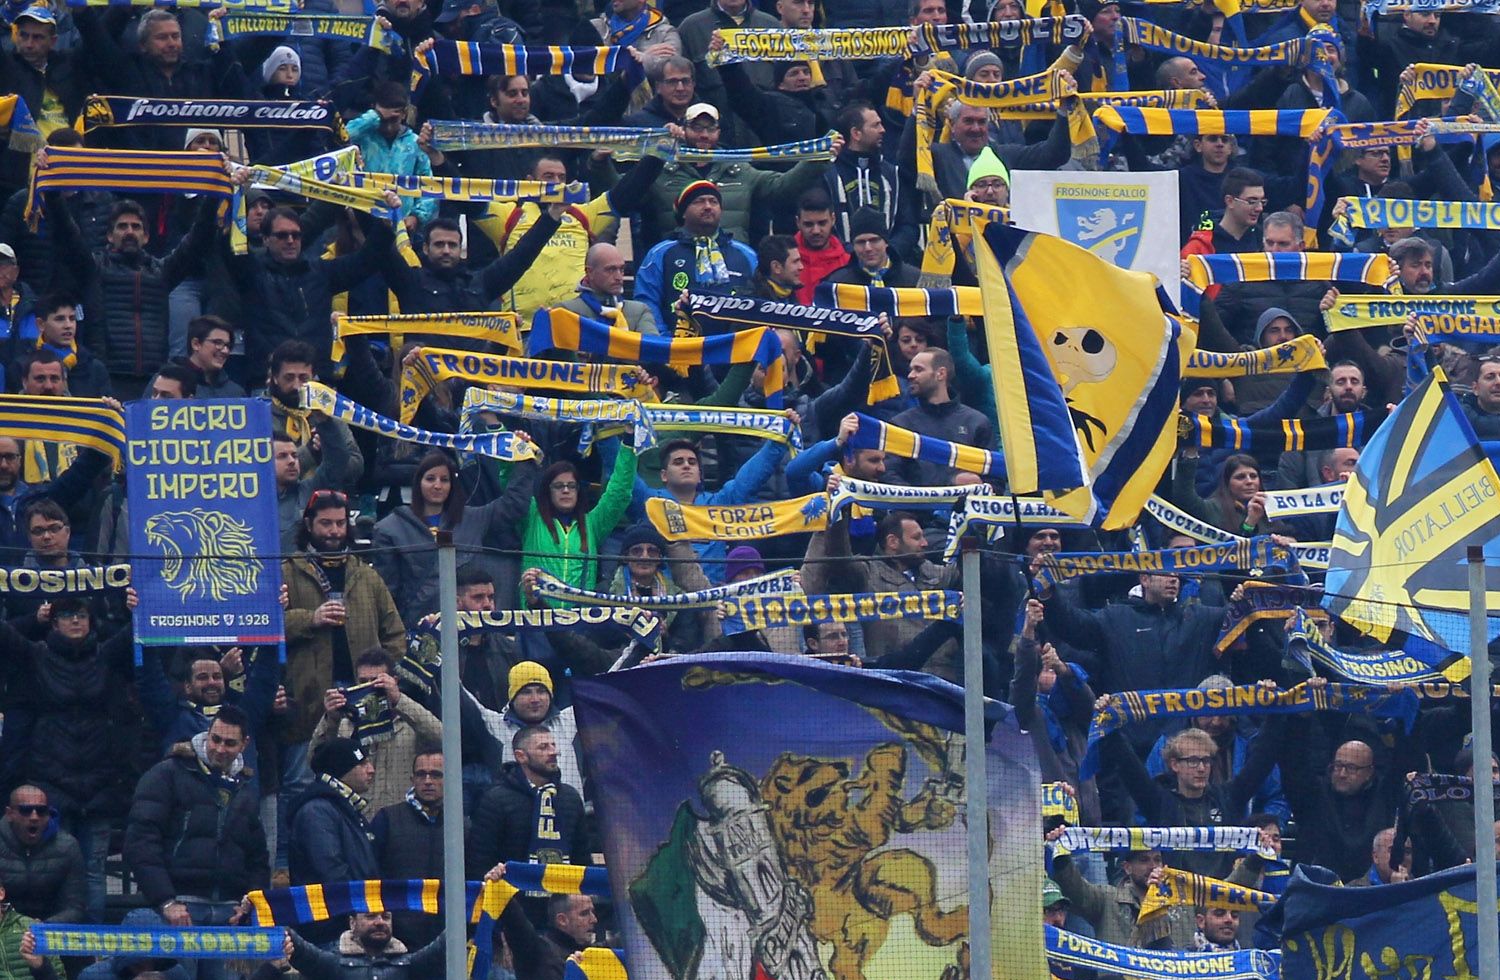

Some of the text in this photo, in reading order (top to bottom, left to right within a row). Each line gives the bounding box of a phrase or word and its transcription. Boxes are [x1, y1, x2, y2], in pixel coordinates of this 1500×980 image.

[331, 20, 367, 39] NASCE
[1139, 20, 1285, 64] FROSINONE
[735, 29, 907, 58] FORZA FROSINON
[956, 72, 1047, 99] SINONE
[127, 99, 328, 122] frosinone calcio
[1056, 187, 1146, 198] FROSINONE CALCIO
[760, 297, 880, 332] frosinone
[428, 354, 585, 383] FROSINONE
[151, 405, 247, 431] SACRO
[700, 412, 785, 436] MERDA
[128, 437, 272, 466] CIOCIARO
[147, 472, 259, 500] IMPERO
[1302, 491, 1325, 507] LA
[708, 506, 774, 524] FORZA
[971, 501, 1067, 518] CIOCIARI
[712, 521, 776, 539] LEONE
[1060, 546, 1237, 579] CIOCIARI 100%
[737, 570, 793, 596] CUORE
[151, 613, 270, 627] FROSINONE 1928
[457, 605, 659, 637] FROSINON
[46, 931, 271, 953] HEROES KORPS
[1058, 929, 1236, 974] FORZA FROSINONE
